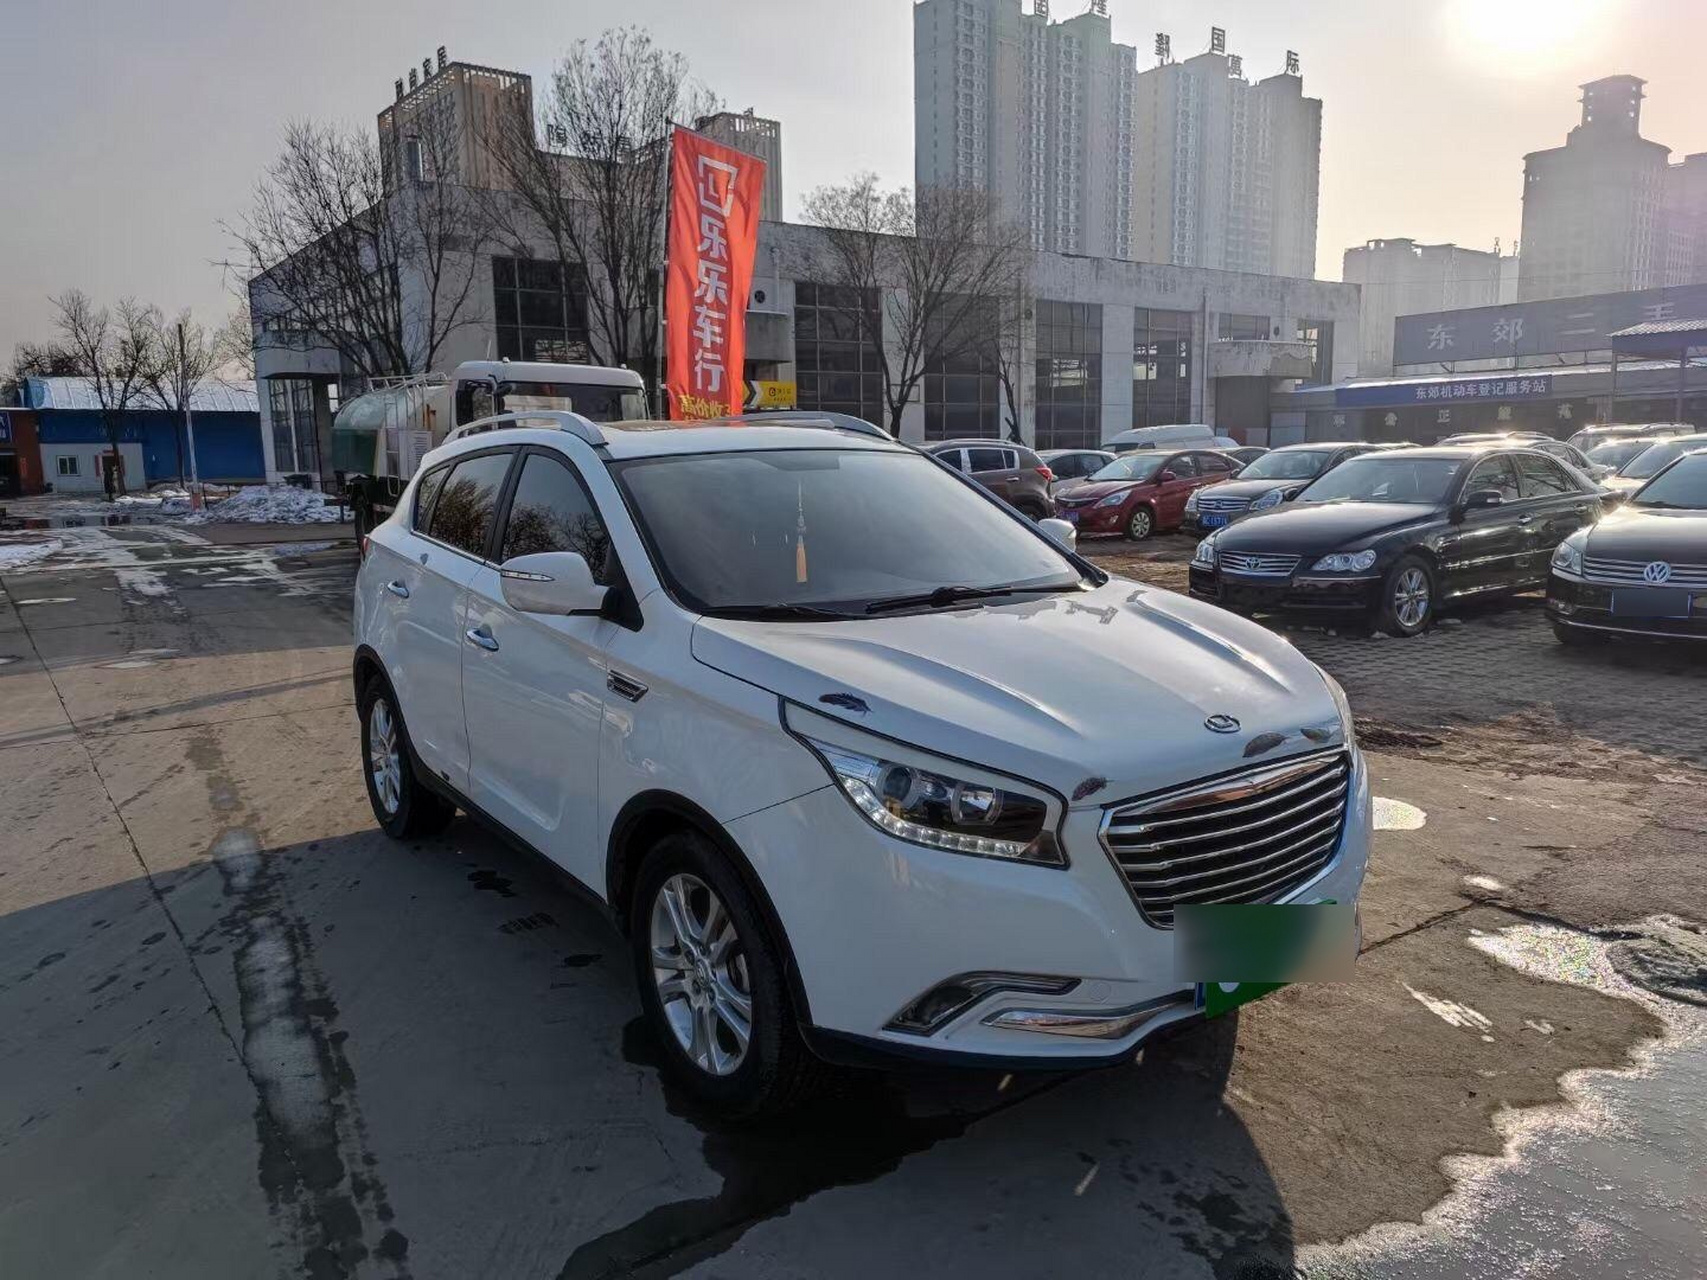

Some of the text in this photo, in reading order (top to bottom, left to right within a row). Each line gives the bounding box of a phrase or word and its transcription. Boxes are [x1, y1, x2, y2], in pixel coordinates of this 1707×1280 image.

[1415, 378, 1547, 400] 东郊机动车登记服务站
